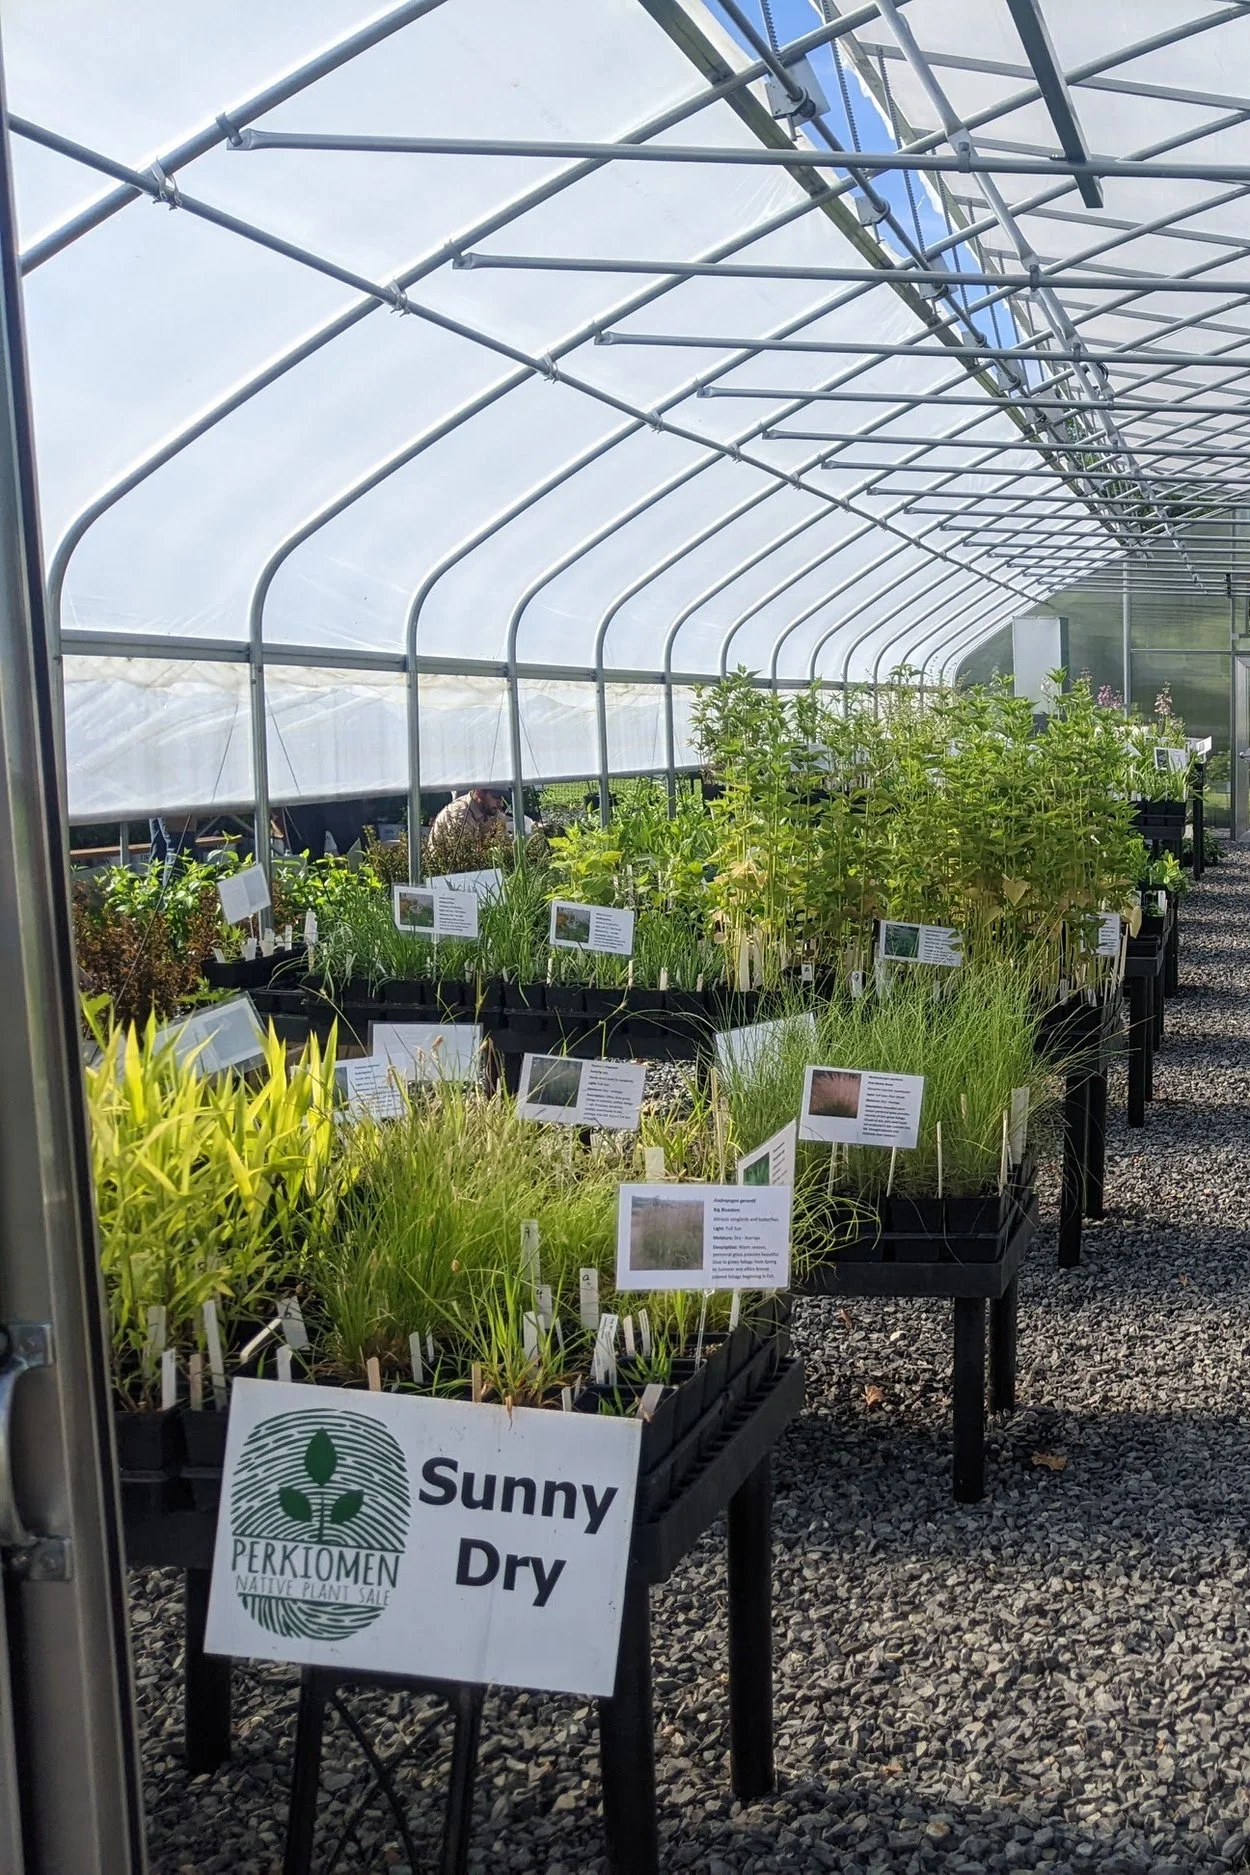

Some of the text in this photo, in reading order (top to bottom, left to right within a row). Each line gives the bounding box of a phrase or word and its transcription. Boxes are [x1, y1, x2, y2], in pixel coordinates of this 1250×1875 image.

[418, 1456, 618, 1534] Sunny
[231, 1538, 400, 1588] PERKIOMEN
[235, 1574, 390, 1606] NATIVE PLANT SALE
[456, 1538, 567, 1606] Dry
